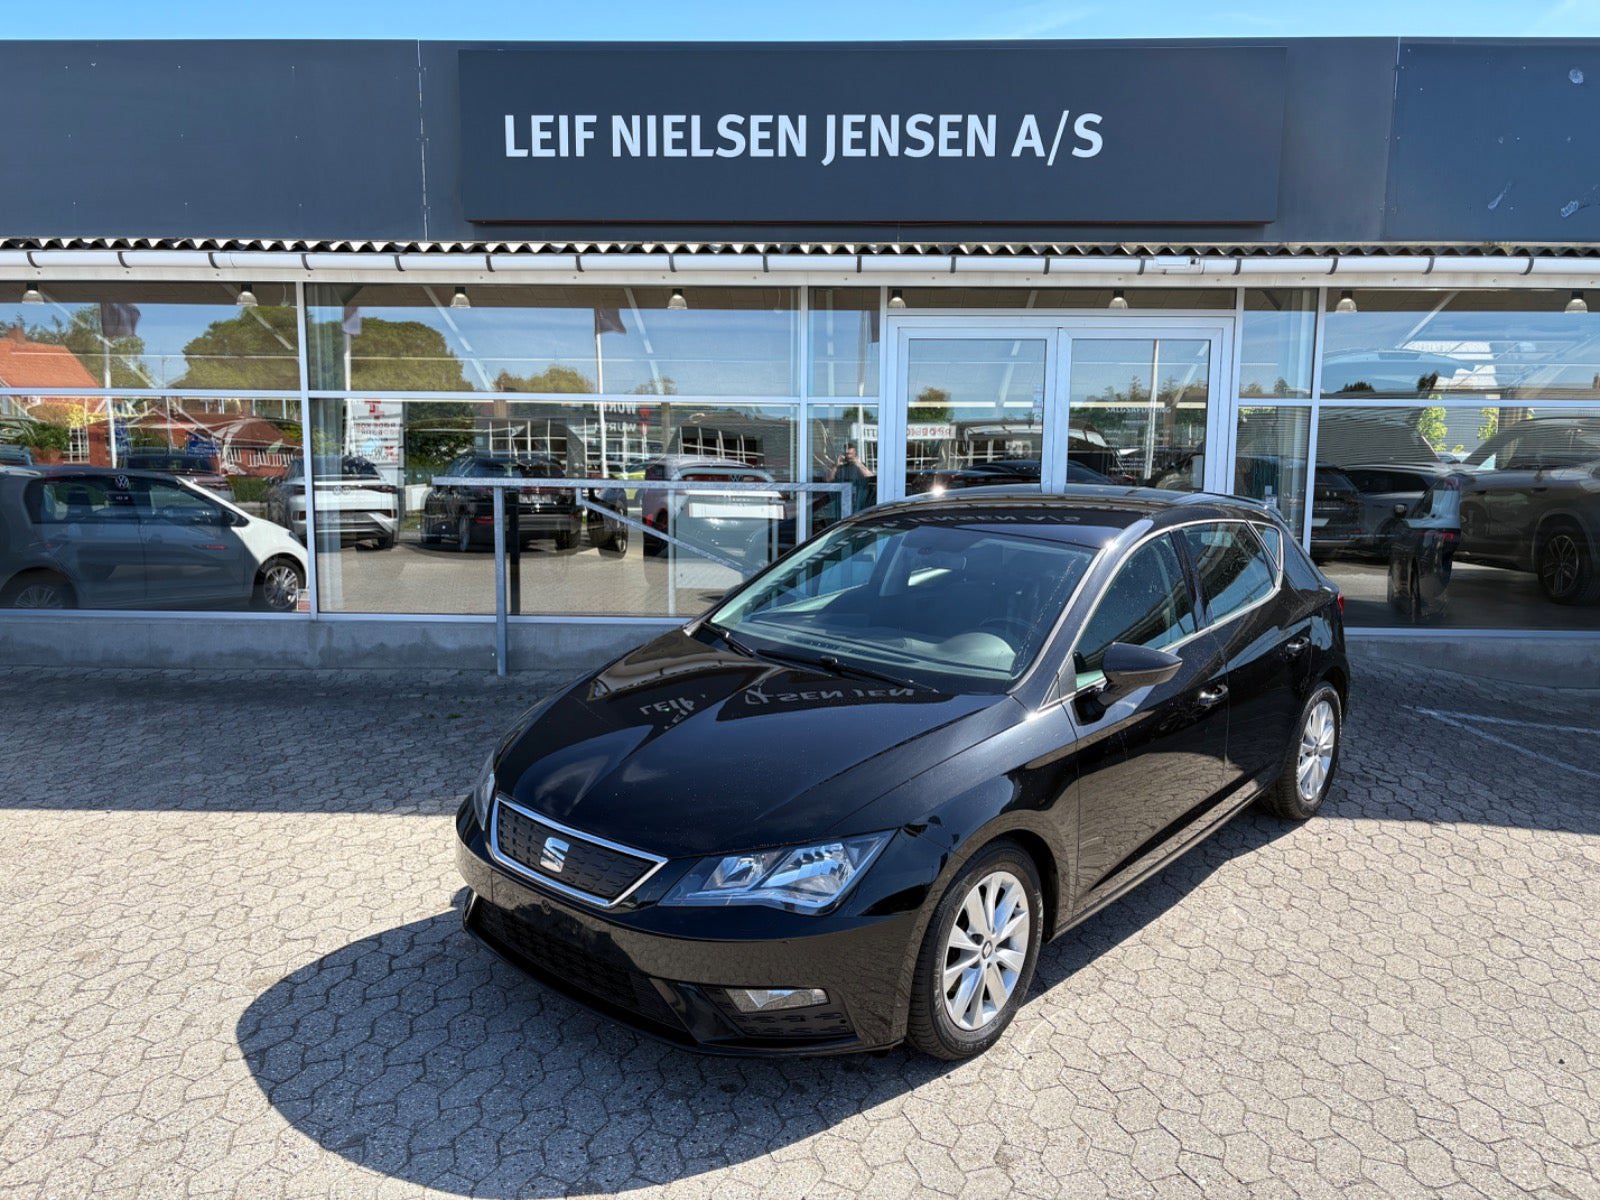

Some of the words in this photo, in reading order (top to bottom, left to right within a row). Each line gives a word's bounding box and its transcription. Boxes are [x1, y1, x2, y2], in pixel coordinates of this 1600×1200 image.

[504, 114, 597, 157] LEIF
[612, 114, 807, 158] NIELSEN
[821, 113, 997, 166] JENSEN
[1011, 110, 1103, 166] A/S
